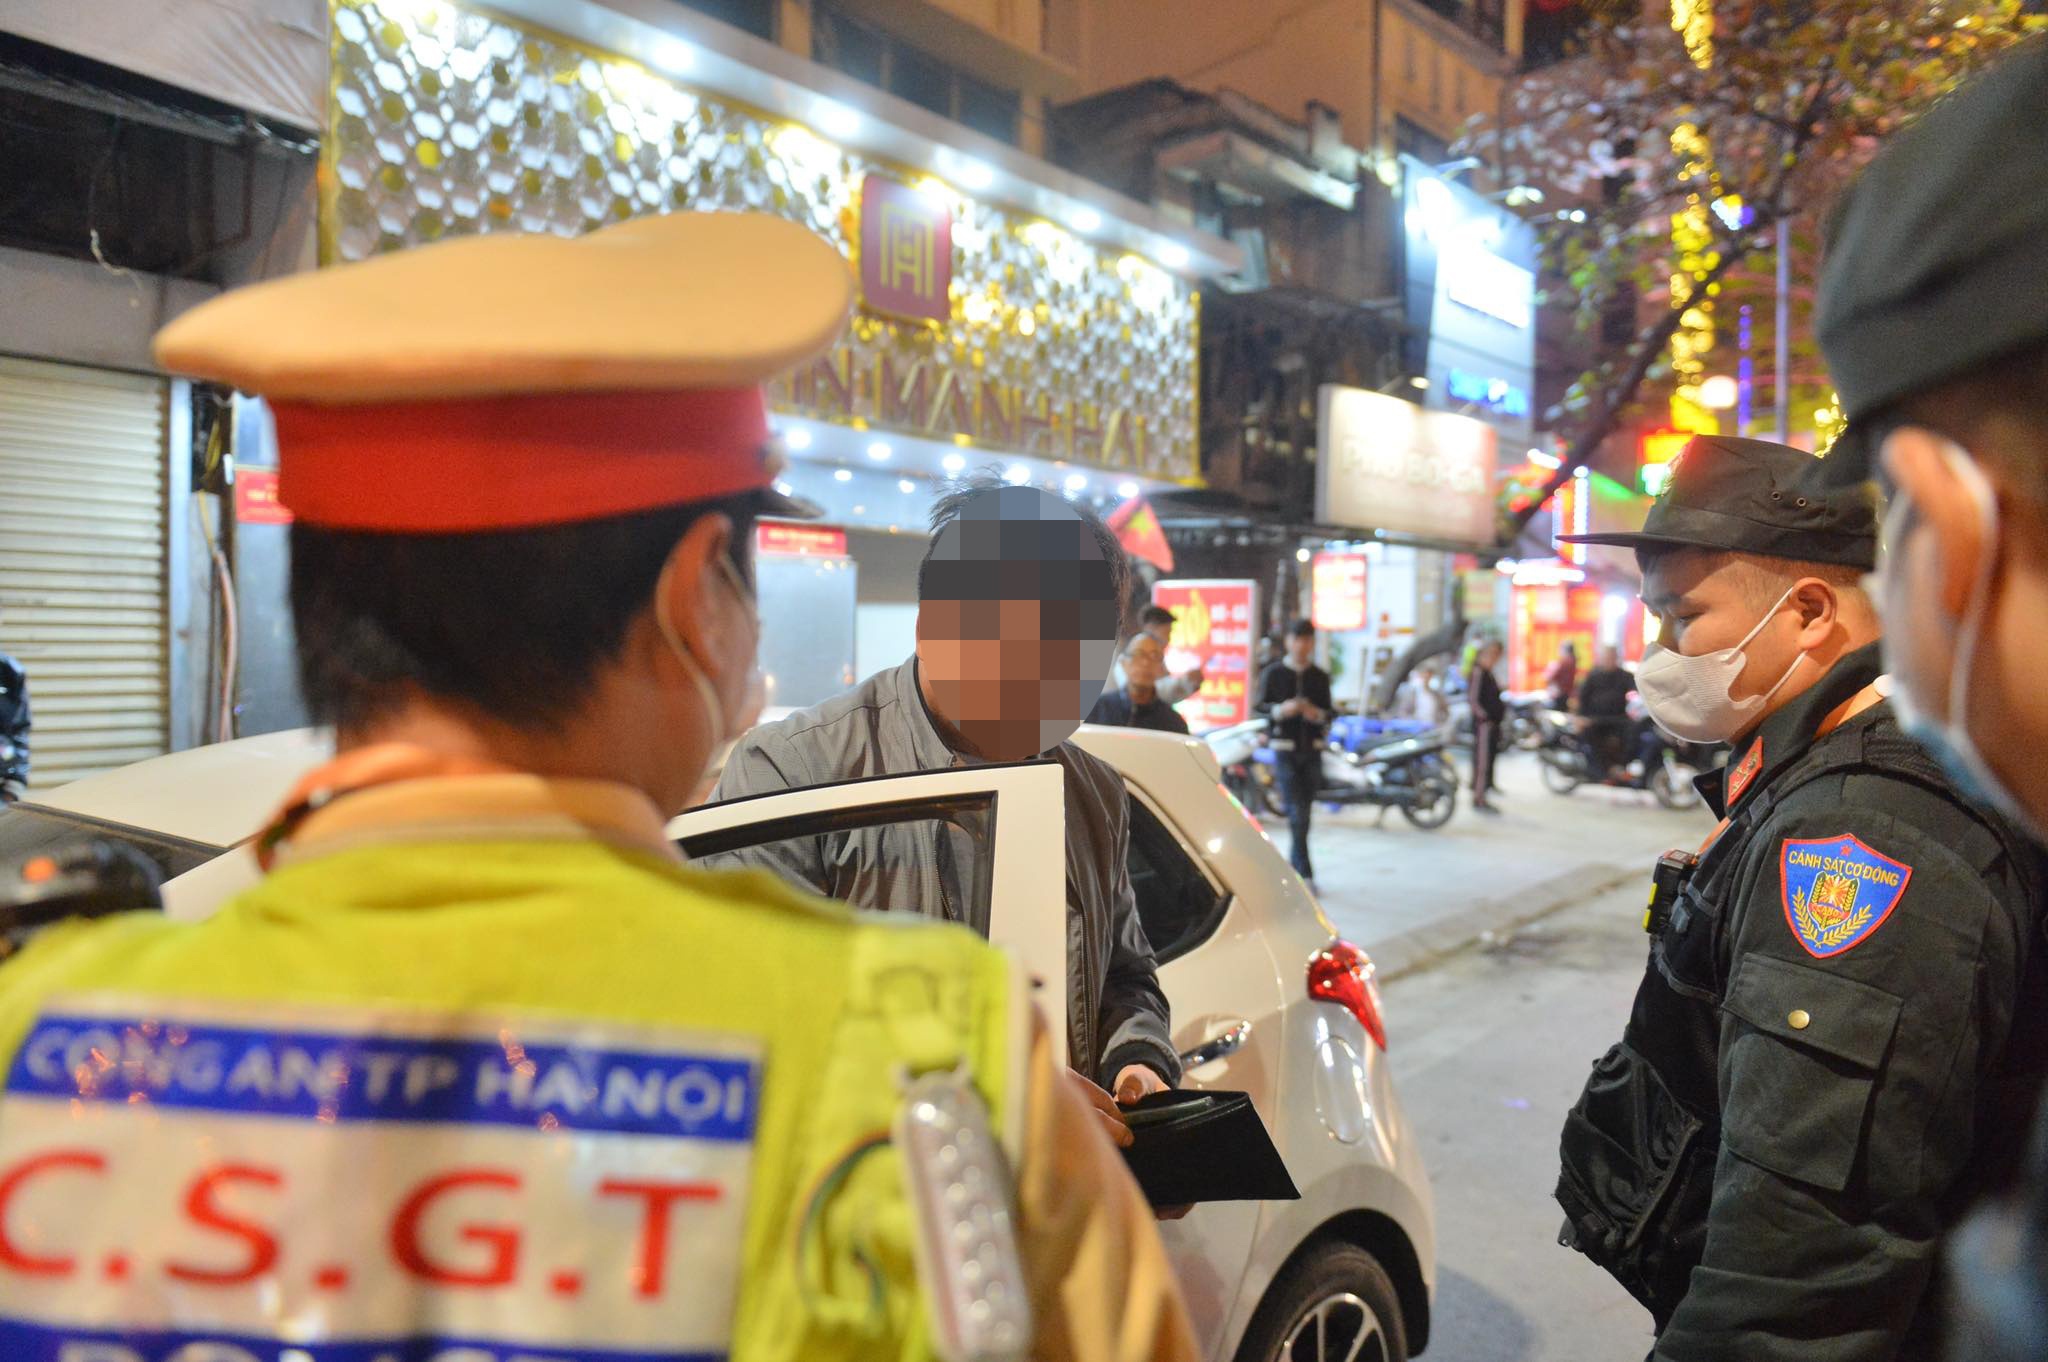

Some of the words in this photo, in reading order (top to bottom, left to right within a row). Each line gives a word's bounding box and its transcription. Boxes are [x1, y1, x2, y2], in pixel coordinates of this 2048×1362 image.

[1862, 865, 1900, 887] ĐỘNG
[225, 1046, 349, 1101] AN
[360, 1049, 459, 1106] TP
